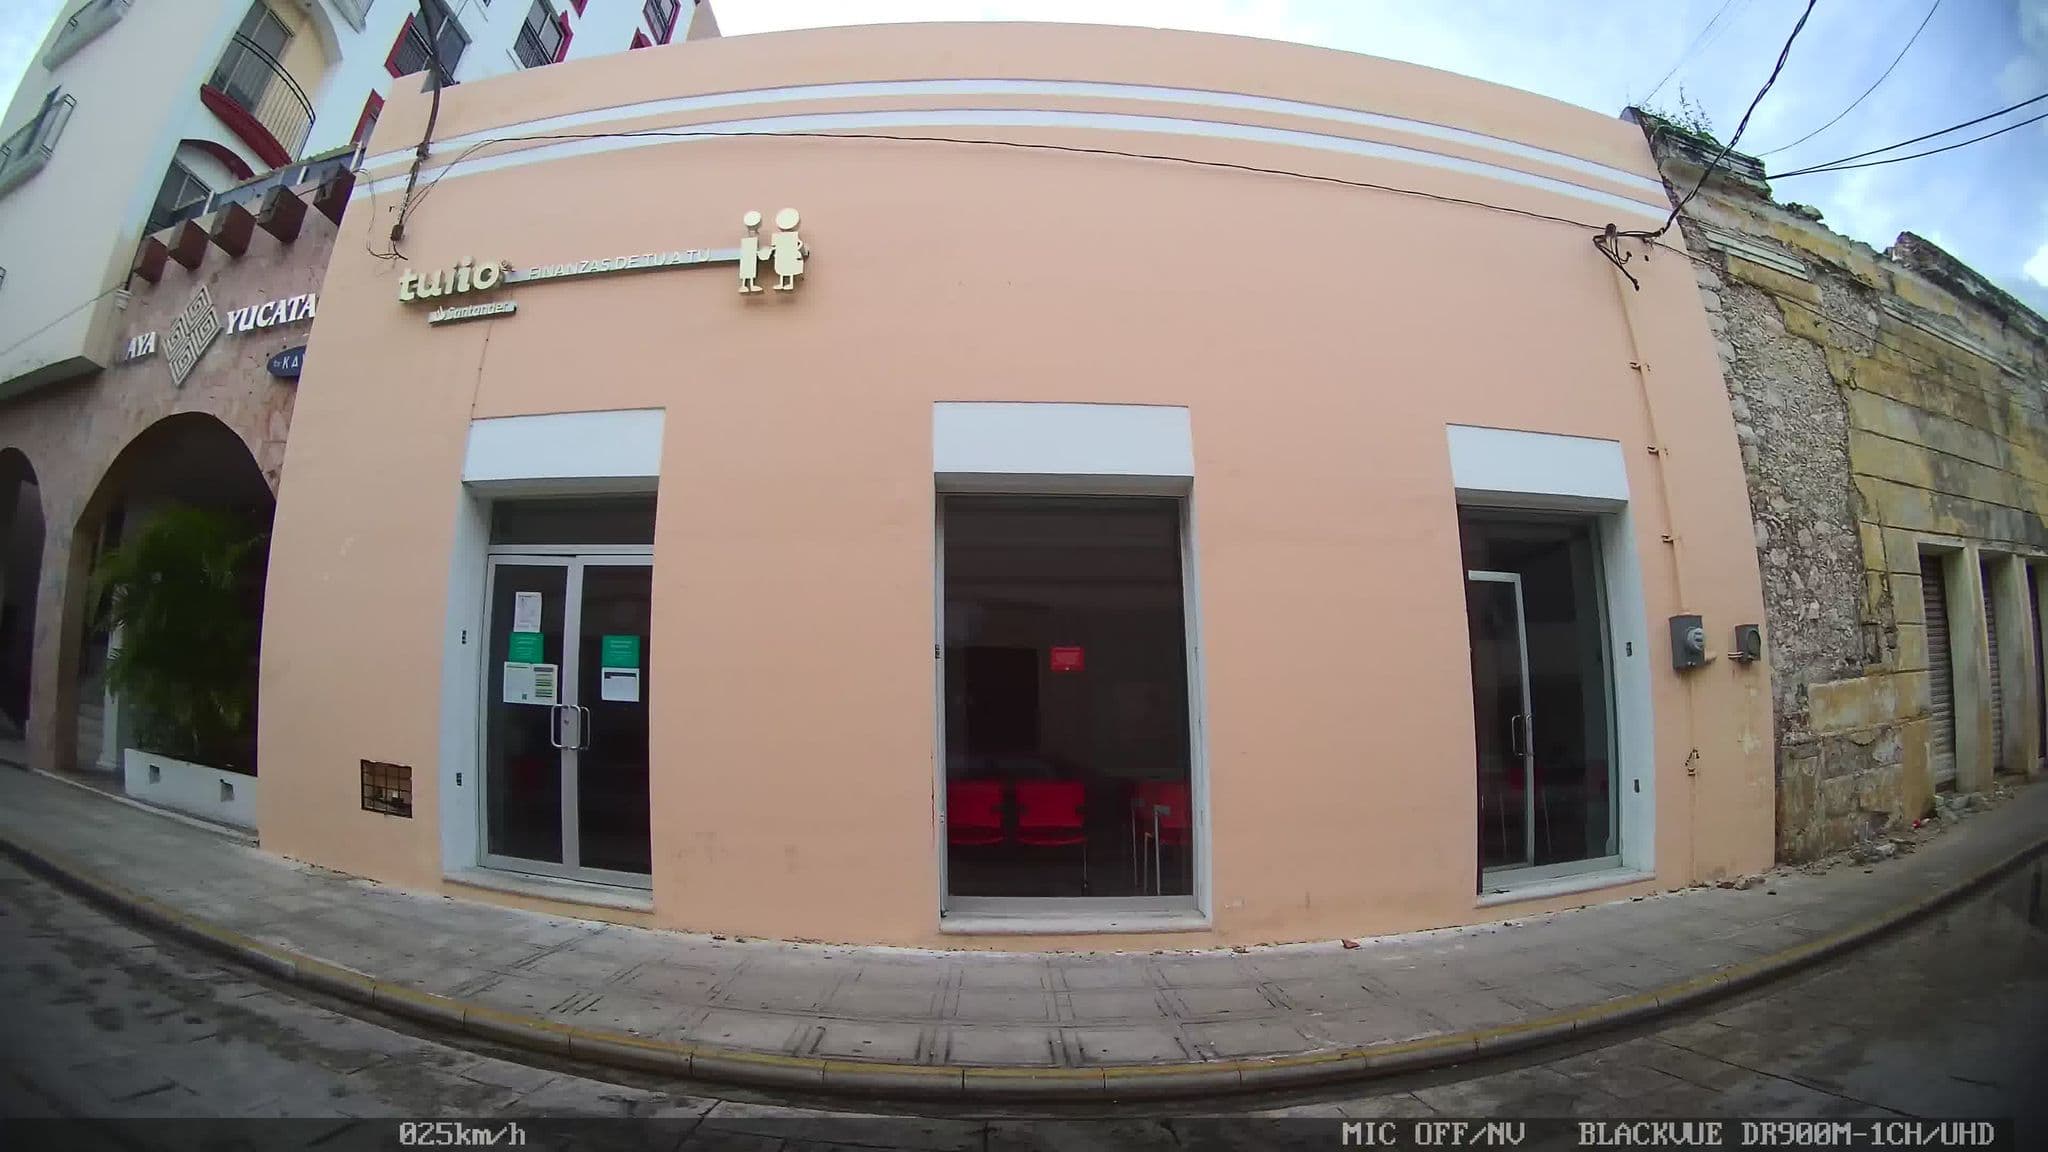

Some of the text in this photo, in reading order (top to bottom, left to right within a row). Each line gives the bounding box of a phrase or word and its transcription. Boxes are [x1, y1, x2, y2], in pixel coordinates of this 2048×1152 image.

[528, 258, 611, 280] FINANZAS
[614, 255, 641, 270] DE
[669, 251, 682, 264] A
[444, 301, 512, 321] Santander
[125, 292, 317, 361] AYA YUCATA
